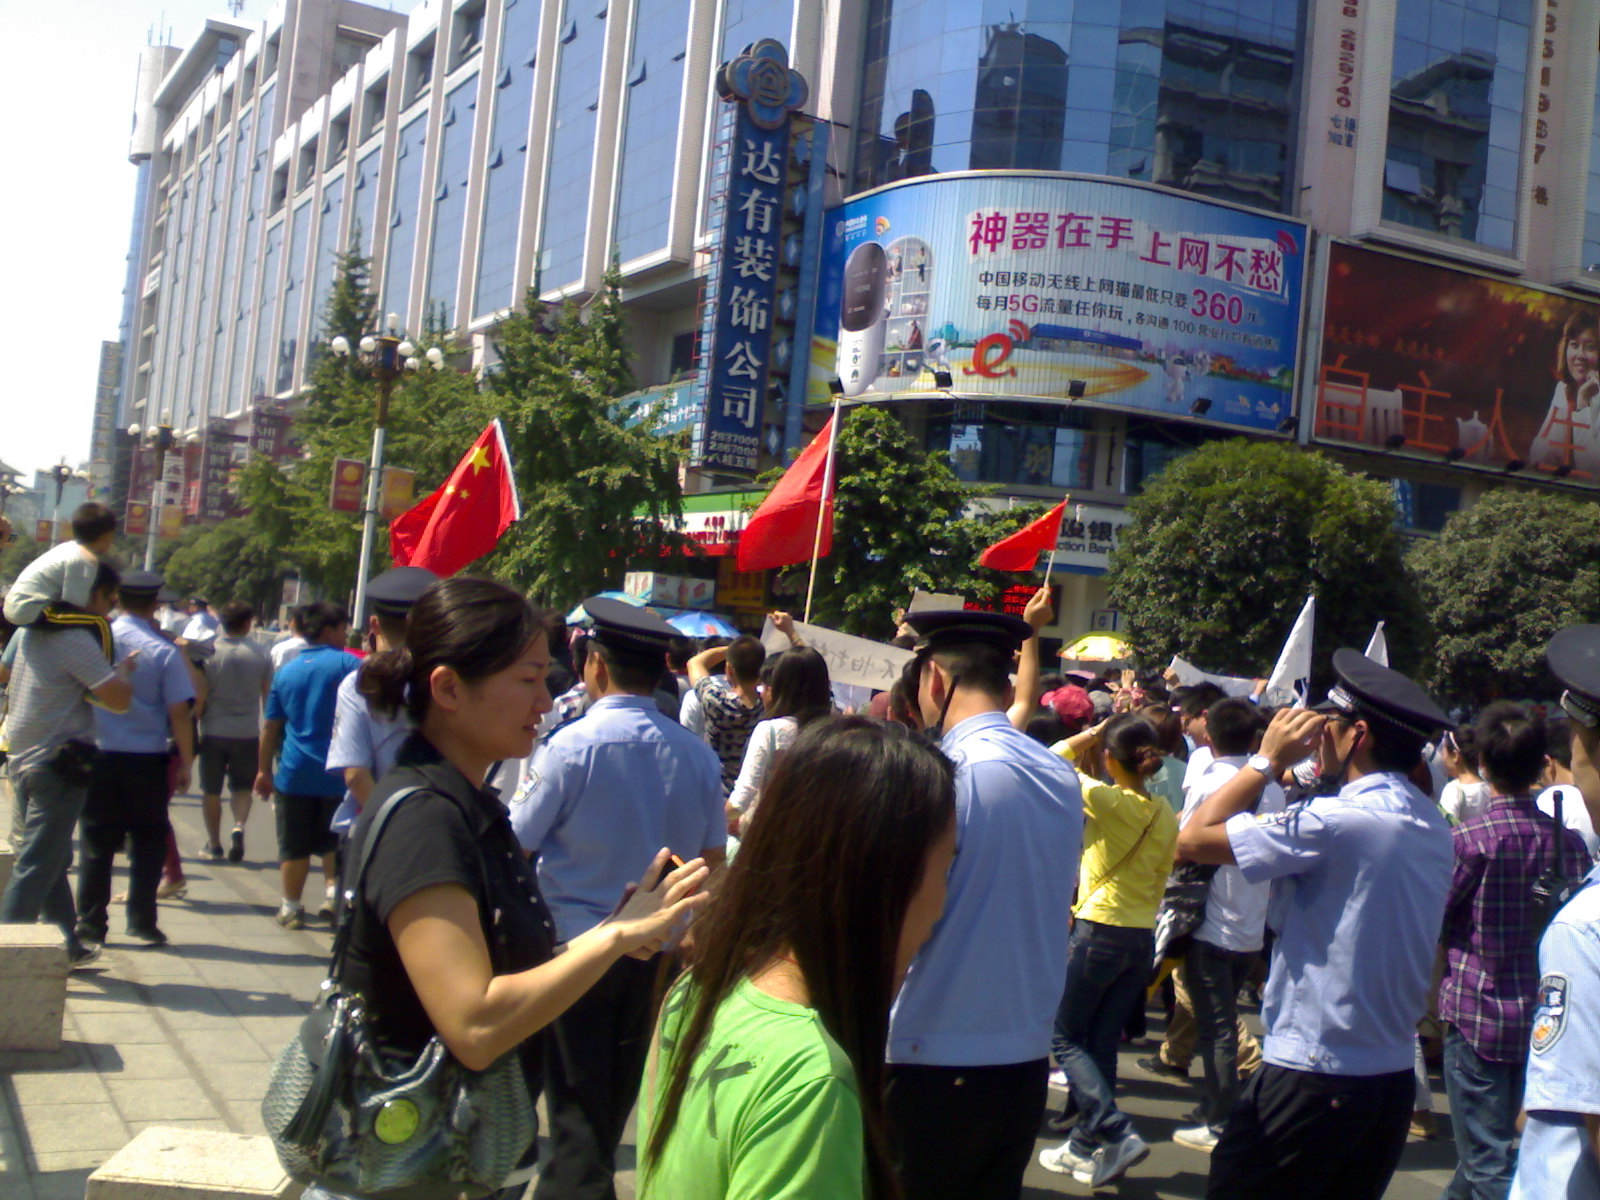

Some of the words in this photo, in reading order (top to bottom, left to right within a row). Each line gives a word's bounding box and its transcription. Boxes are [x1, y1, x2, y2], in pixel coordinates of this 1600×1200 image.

[721, 139, 781, 430] 达有装饰公司
[968, 212, 1133, 255] 神器在手
[1139, 231, 1281, 293] 上网不愁
